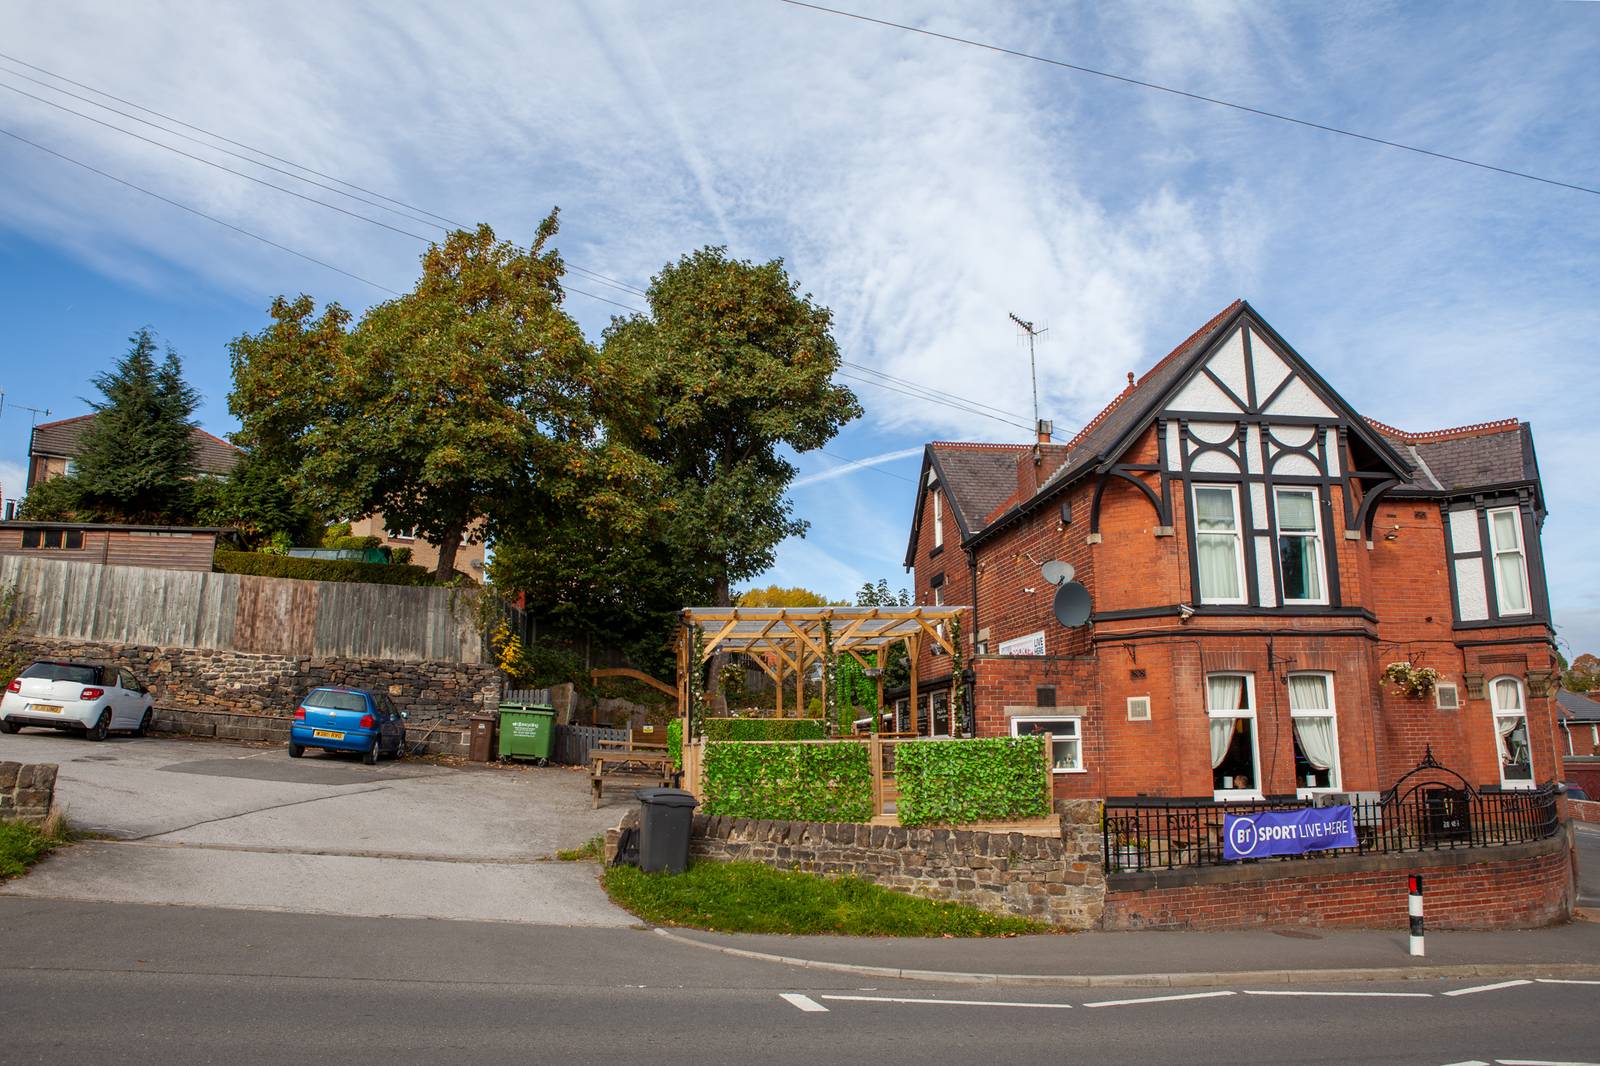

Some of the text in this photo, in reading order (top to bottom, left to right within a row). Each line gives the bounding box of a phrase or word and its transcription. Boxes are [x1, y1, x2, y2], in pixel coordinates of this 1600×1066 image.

[1237, 819, 1349, 844] BT SPORT LIVE HERE
